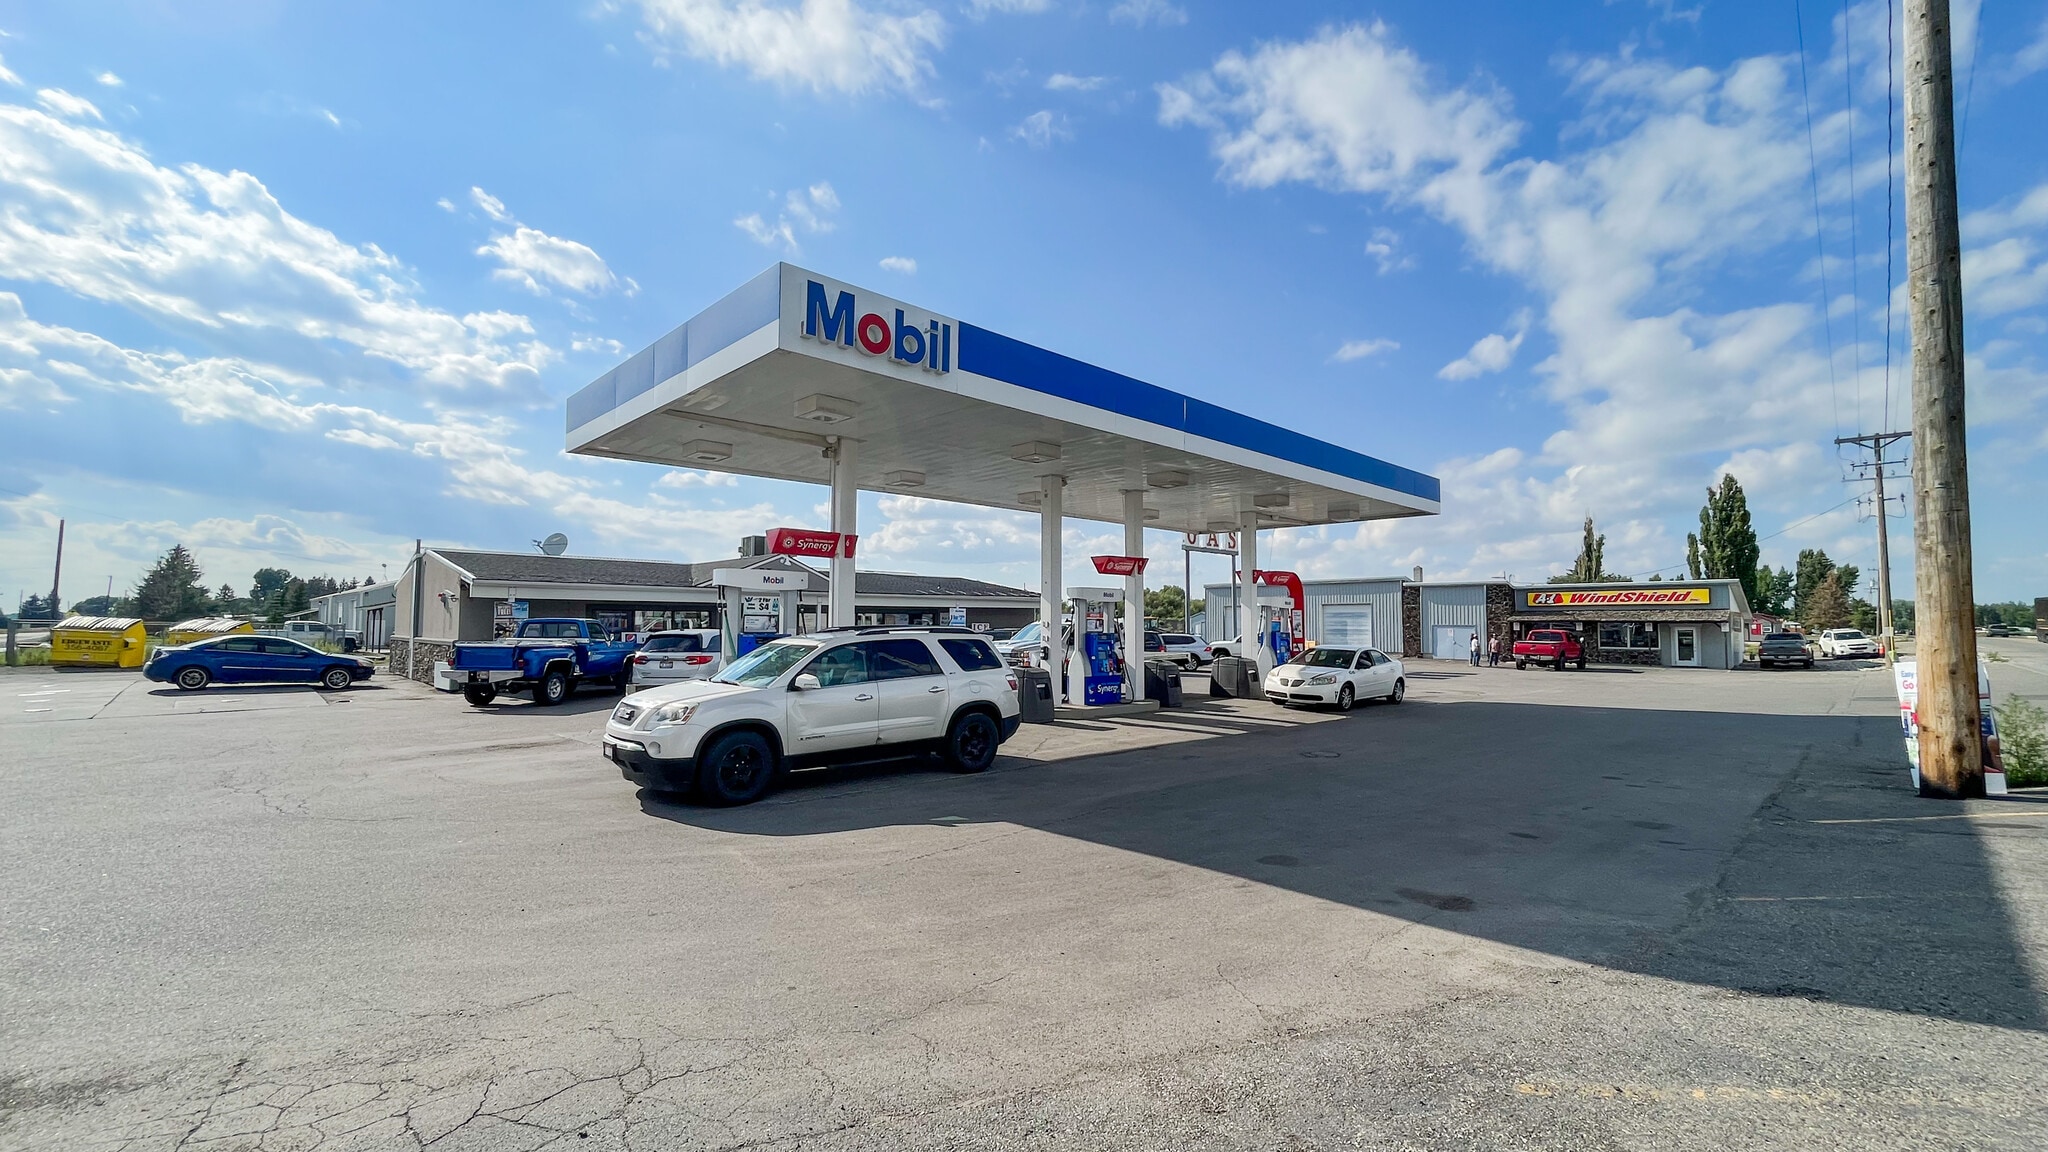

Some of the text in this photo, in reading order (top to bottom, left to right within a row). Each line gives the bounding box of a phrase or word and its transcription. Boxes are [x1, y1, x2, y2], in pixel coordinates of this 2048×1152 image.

[804, 279, 951, 373] Mobil
[797, 539, 834, 552] Synergy
[845, 539, 850, 547] 6
[762, 576, 784, 584] Mobil
[1570, 591, 1692, 603] WindShield
[1901, 671, 1914, 679] Easy
[1902, 680, 1914, 690] Go
